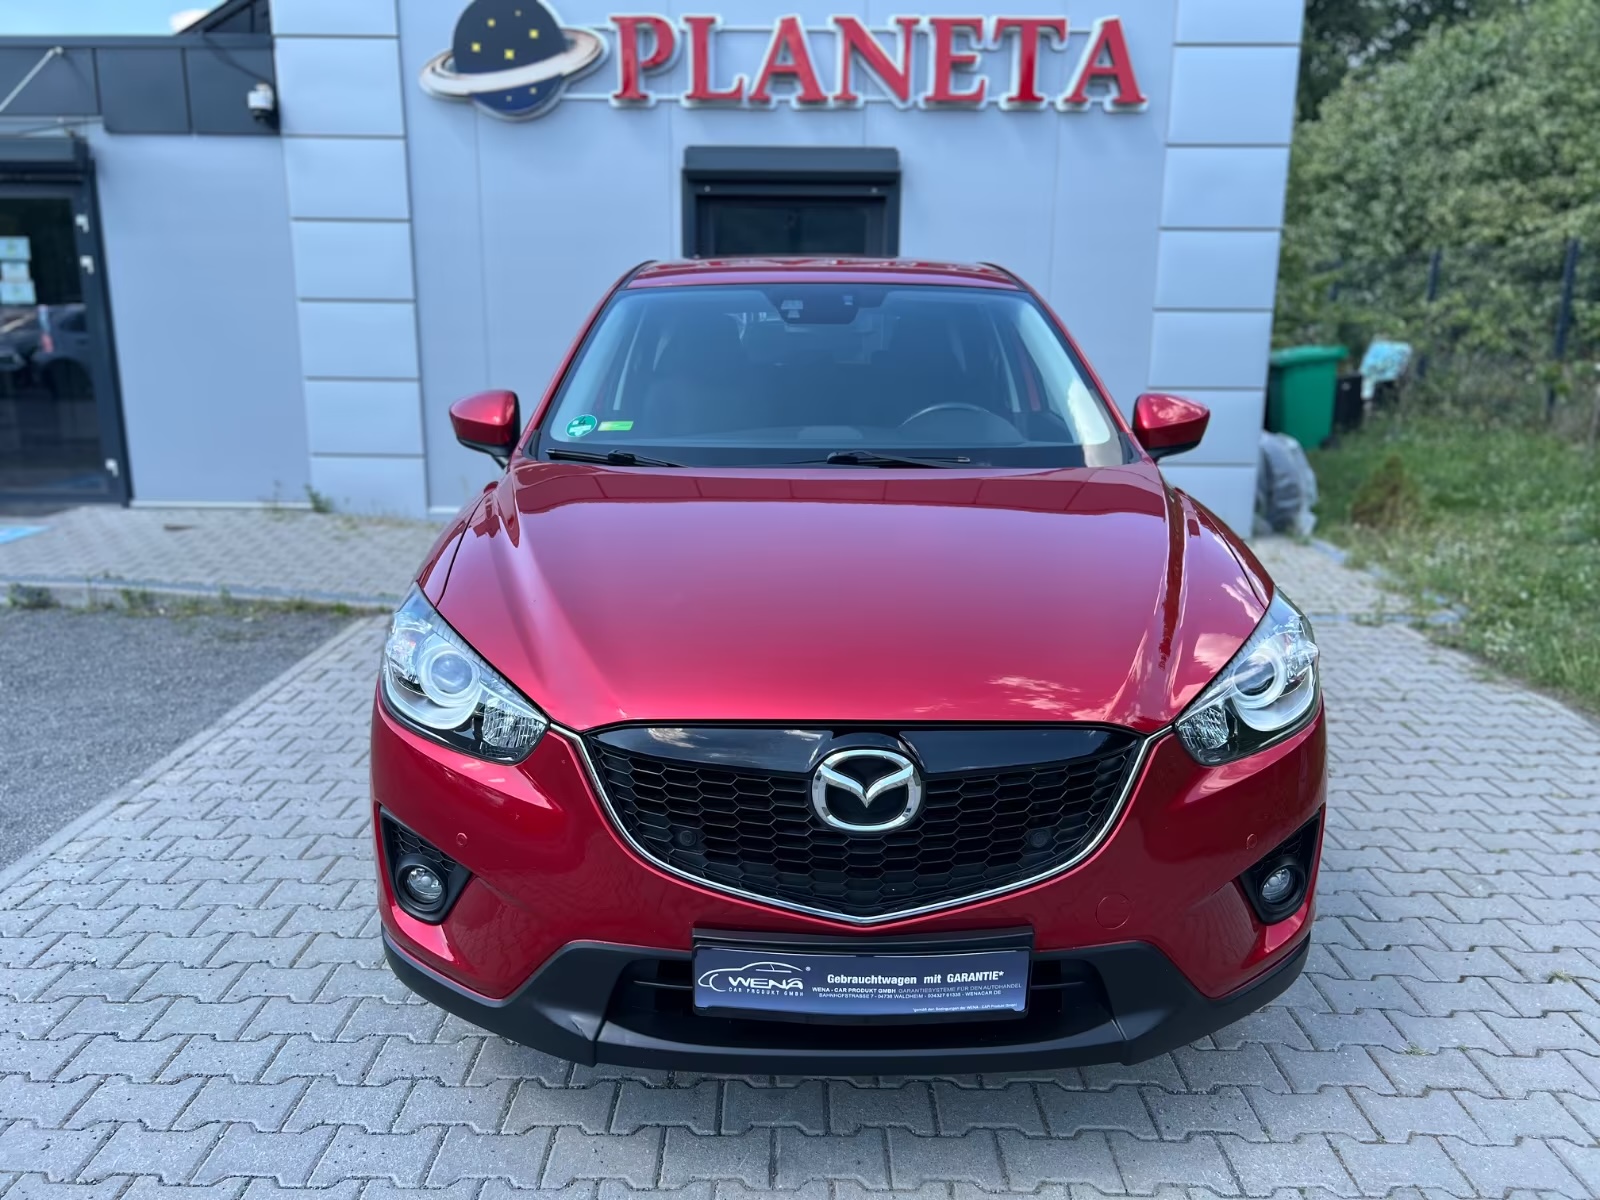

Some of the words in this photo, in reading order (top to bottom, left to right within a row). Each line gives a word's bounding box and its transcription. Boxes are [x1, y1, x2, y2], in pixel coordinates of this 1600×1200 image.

[607, 14, 1148, 107] PLANETA
[728, 976, 804, 990] WENA
[827, 974, 917, 986] Gebrauchtwagen
[923, 974, 942, 984] mit
[746, 988, 780, 996] PRODUKT
